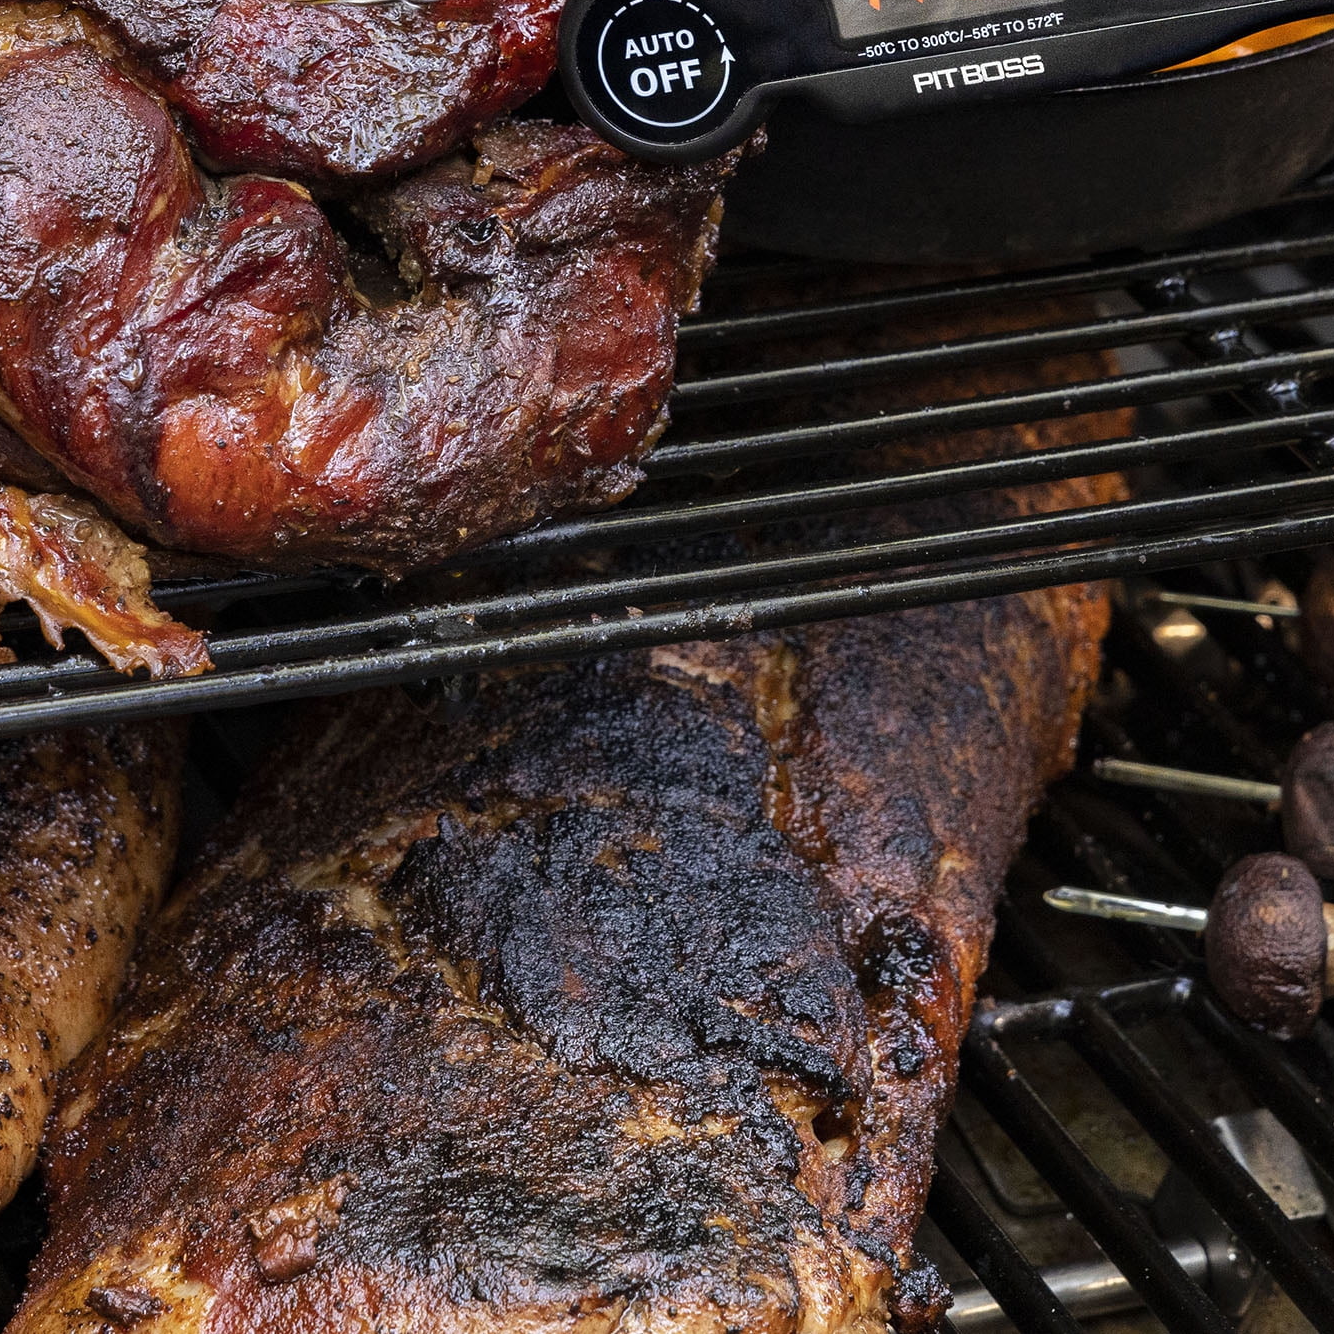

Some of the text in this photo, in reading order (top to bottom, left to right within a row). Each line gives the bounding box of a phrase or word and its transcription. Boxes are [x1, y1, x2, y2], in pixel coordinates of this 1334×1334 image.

[624, 29, 695, 60] AUTO
[898, 38, 920, 53] TO
[1003, 20, 1026, 35] TO
[1027, 12, 1065, 31] 572°F
[629, 58, 702, 98] OFF
